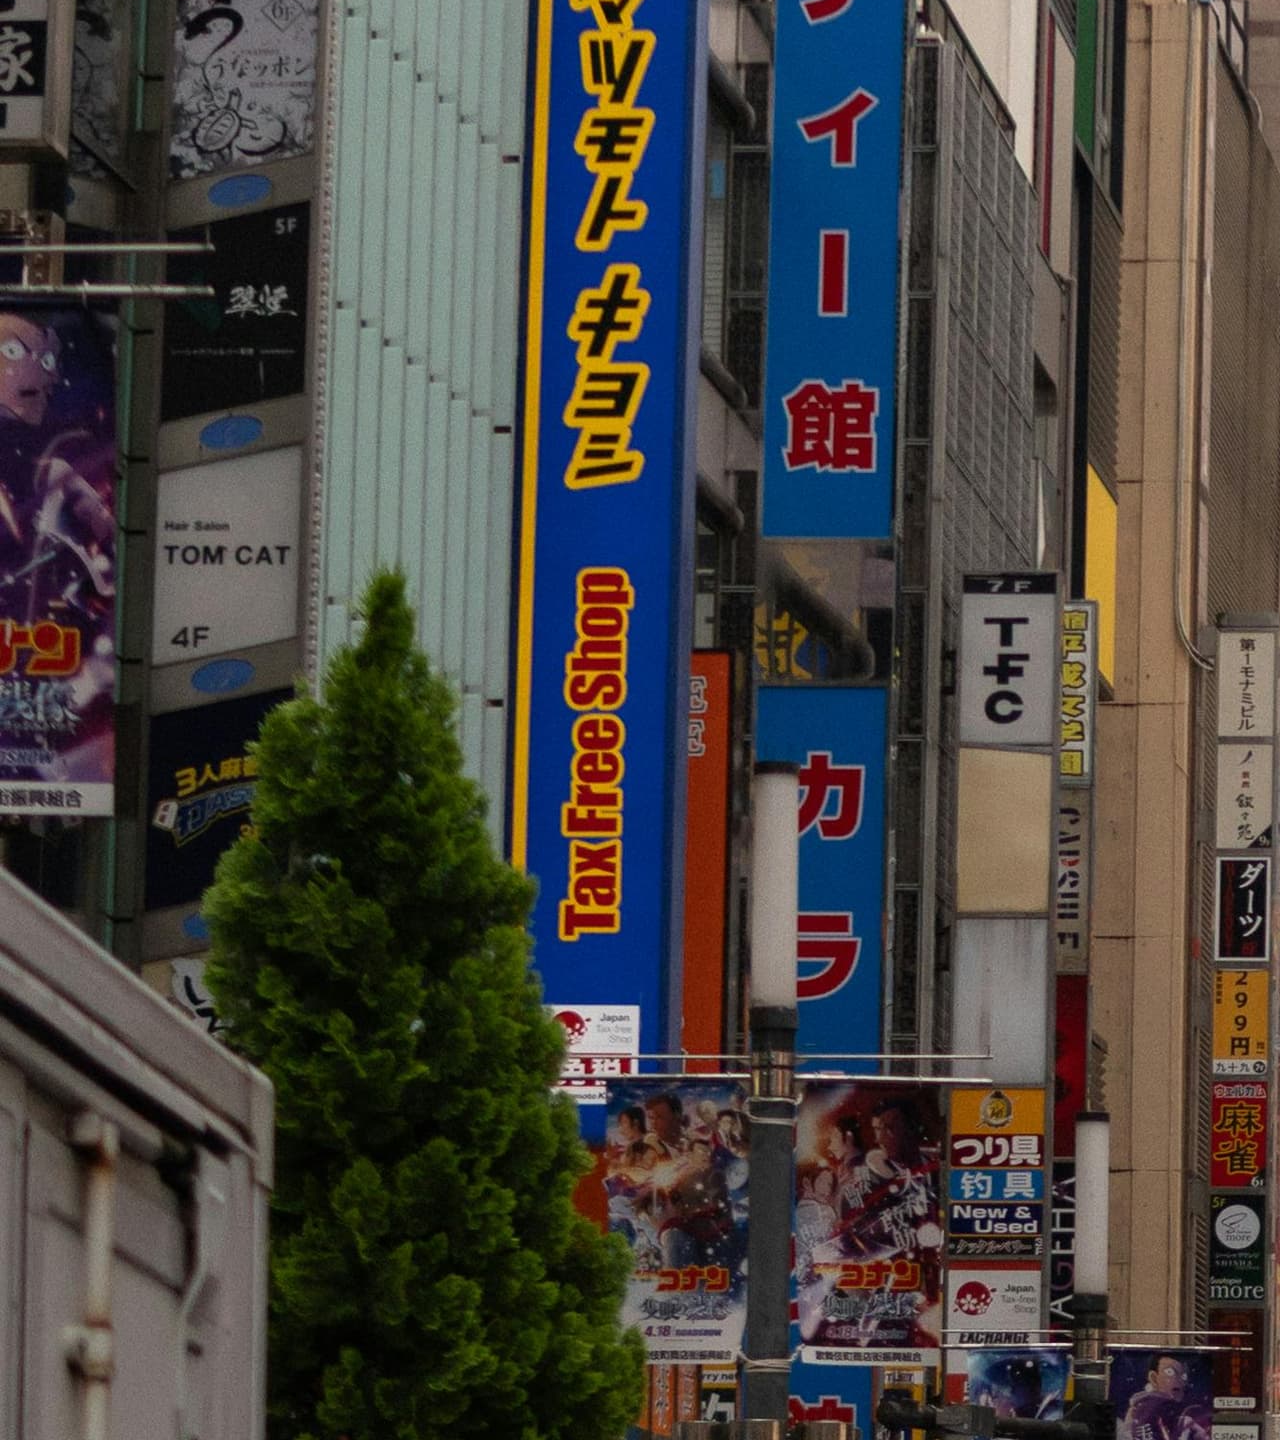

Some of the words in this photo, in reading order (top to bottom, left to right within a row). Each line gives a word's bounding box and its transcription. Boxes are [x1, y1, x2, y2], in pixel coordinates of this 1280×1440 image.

[274, 217, 298, 235] 5F
[165, 521, 190, 533] Hair
[194, 521, 231, 533] Salon
[164, 544, 223, 566] TOM
[235, 544, 291, 566] CAT
[171, 626, 209, 648] 4F
[563, 567, 634, 713] Shop
[1238, 638, 1257, 732] 第1モナミビル
[561, 713, 627, 838] Free
[558, 837, 623, 942] Tax
[1238, 862, 1262, 938] ダーツ
[953, 1136, 1041, 1166] つり具
[1213, 1100, 1263, 1176] 麻雀
[952, 1205, 1003, 1221] New
[1015, 1205, 1031, 1220] &
[974, 1221, 1038, 1234] Used
[657, 1263, 731, 1293] コナン
[836, 1261, 921, 1292] コナン
[1211, 1285, 1265, 1299] more
